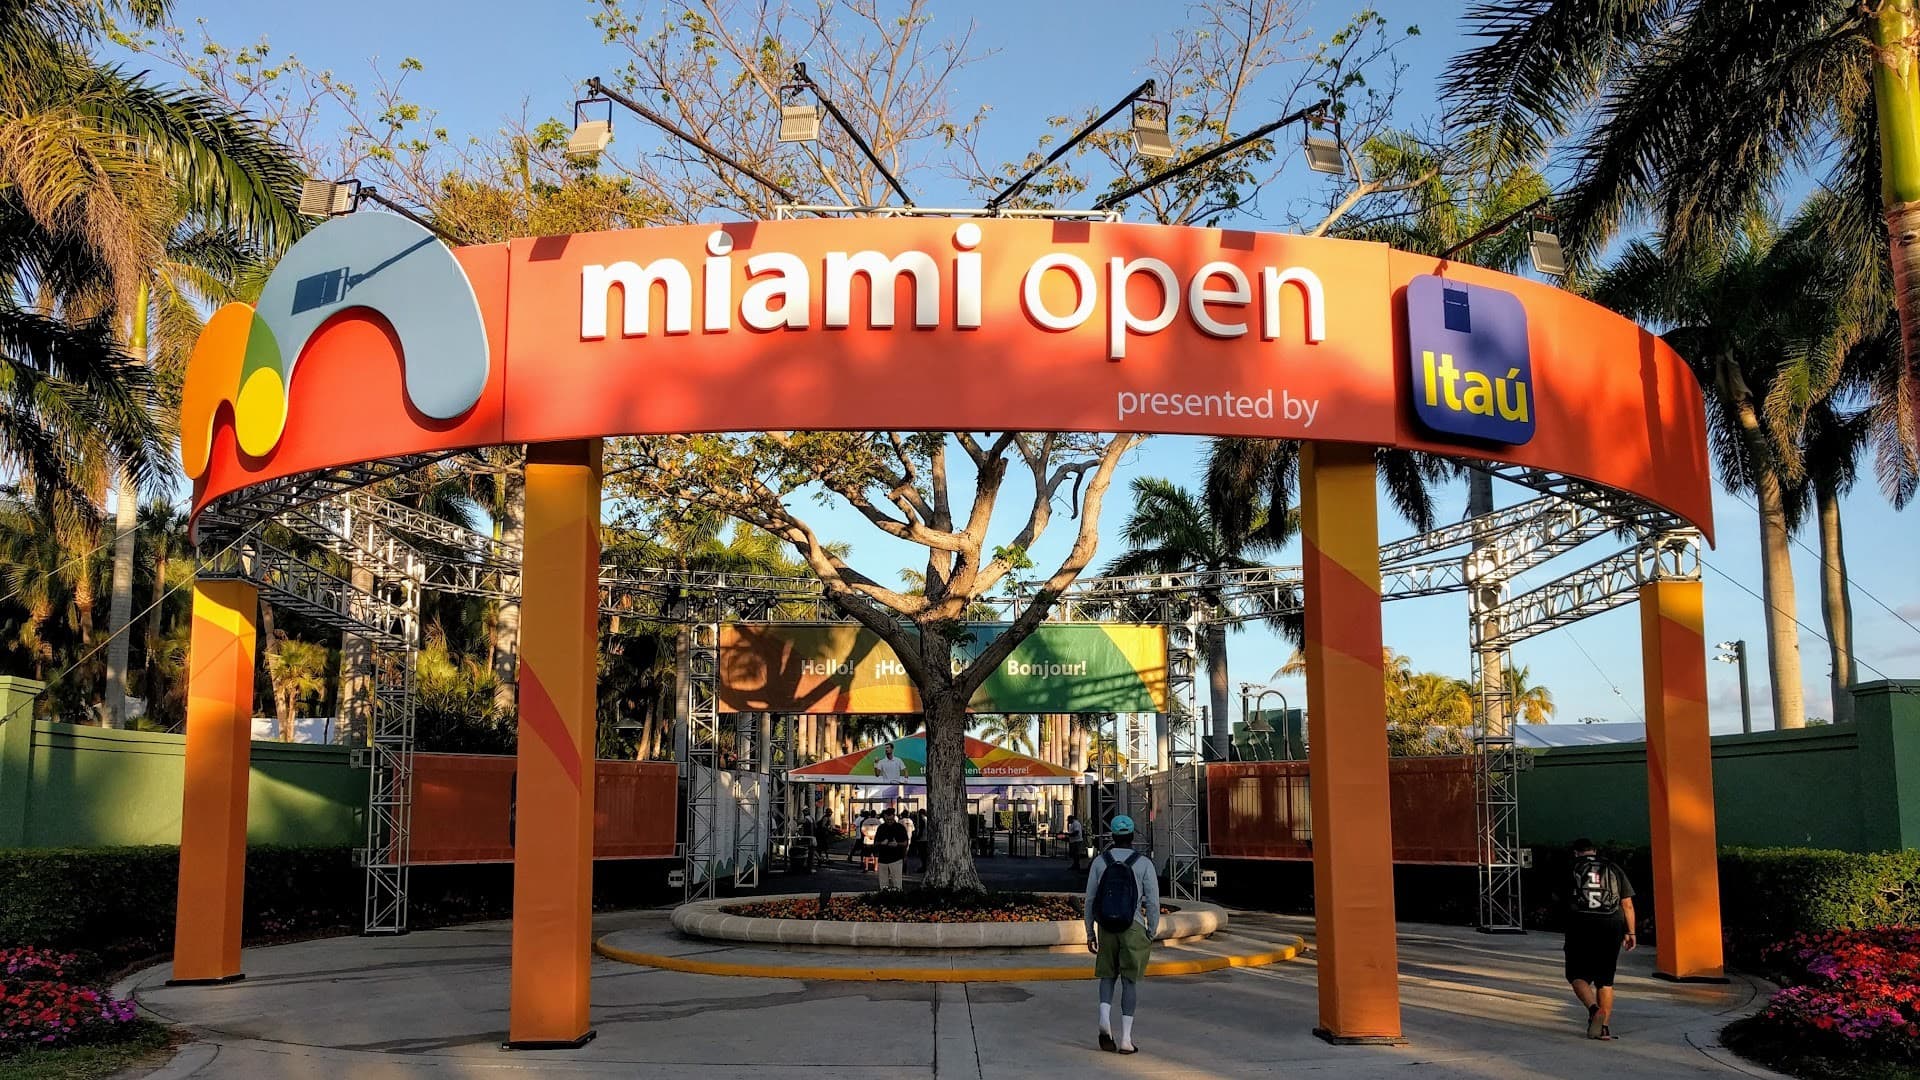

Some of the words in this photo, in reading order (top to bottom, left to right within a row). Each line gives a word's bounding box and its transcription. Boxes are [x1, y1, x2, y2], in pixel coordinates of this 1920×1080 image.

[582, 223, 982, 339] miami
[1024, 252, 1326, 361] open
[1422, 350, 1529, 424] Itaú
[1117, 389, 1274, 421] presented
[1283, 389, 1320, 427] by
[801, 658, 854, 675] Hello!
[1007, 660, 1087, 680] Bonjour!
[983, 767, 1007, 775] starts
[1008, 766, 1030, 775] here!
